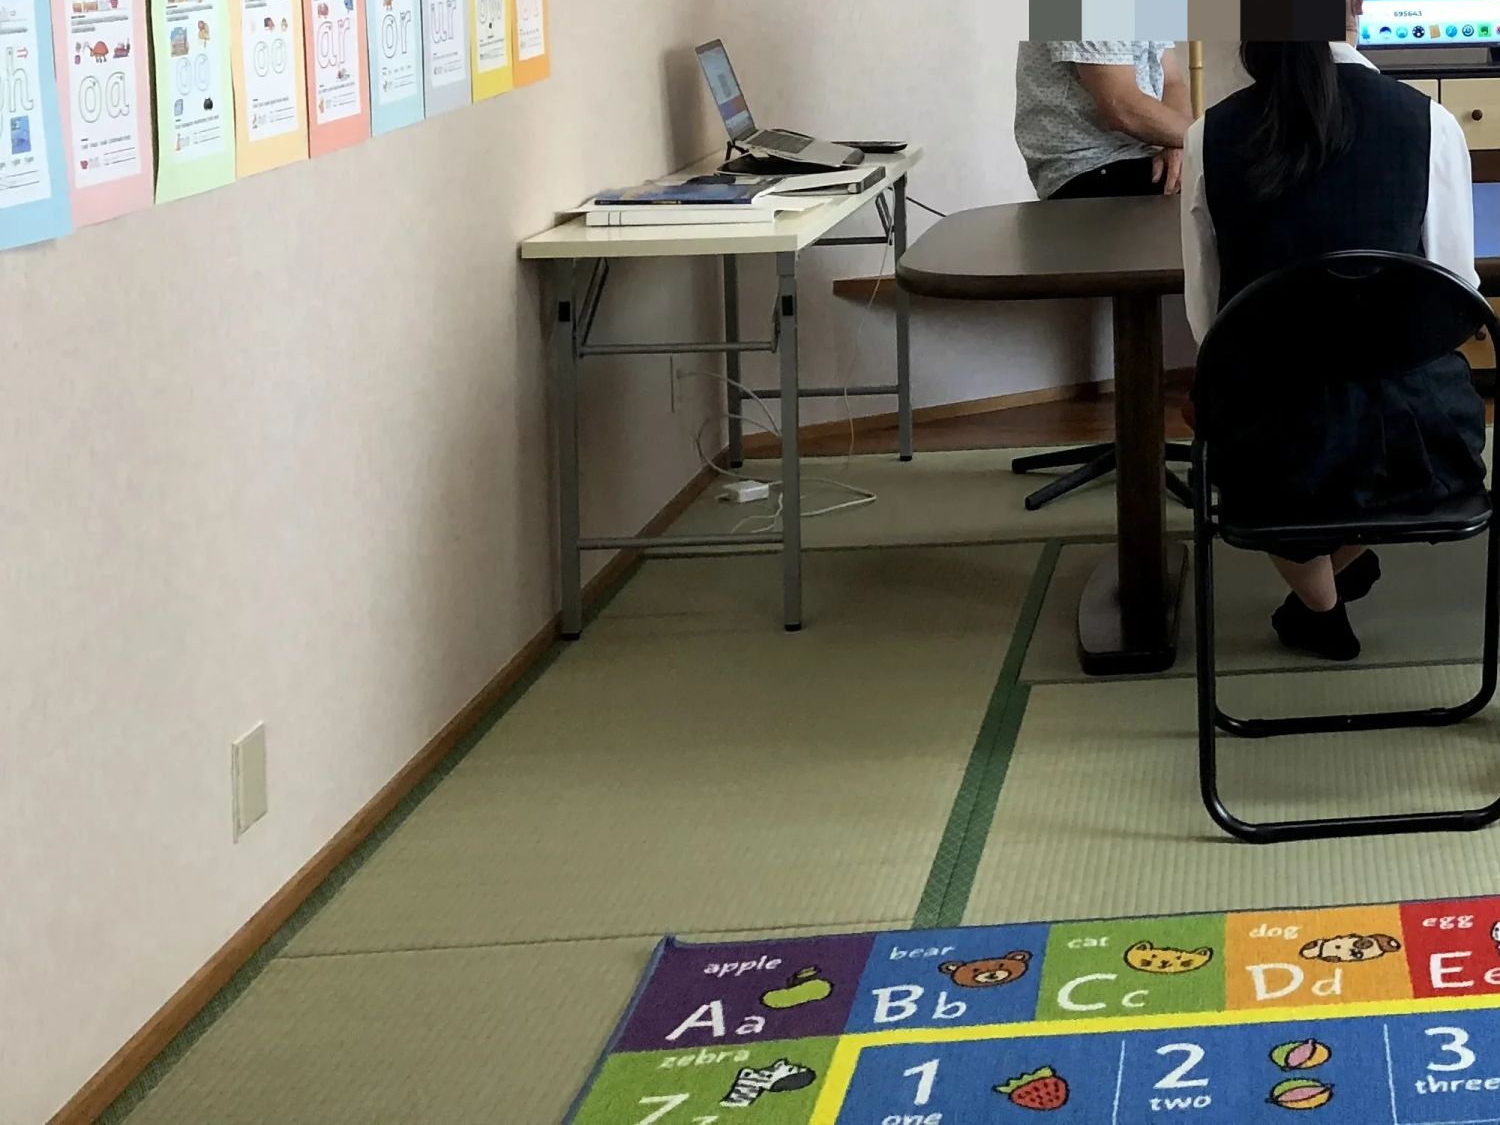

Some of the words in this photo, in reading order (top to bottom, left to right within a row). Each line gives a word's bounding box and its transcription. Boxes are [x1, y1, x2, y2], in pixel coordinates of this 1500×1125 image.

[317, 17, 350, 69] ar
[381, 10, 411, 59] or
[254, 38, 287, 77] oo
[79, 71, 130, 124] oa
[1249, 922, 1302, 941] dog
[1422, 913, 1475, 930] egg
[889, 943, 956, 961] bear
[1067, 934, 1109, 950] cat
[704, 954, 782, 977] apple
[658, 1048, 751, 1070] zebra
[1424, 1025, 1477, 1072] 3
[1153, 1042, 1210, 1090] 2
[903, 1058, 941, 1106] 1
[1149, 1095, 1212, 1111] two
